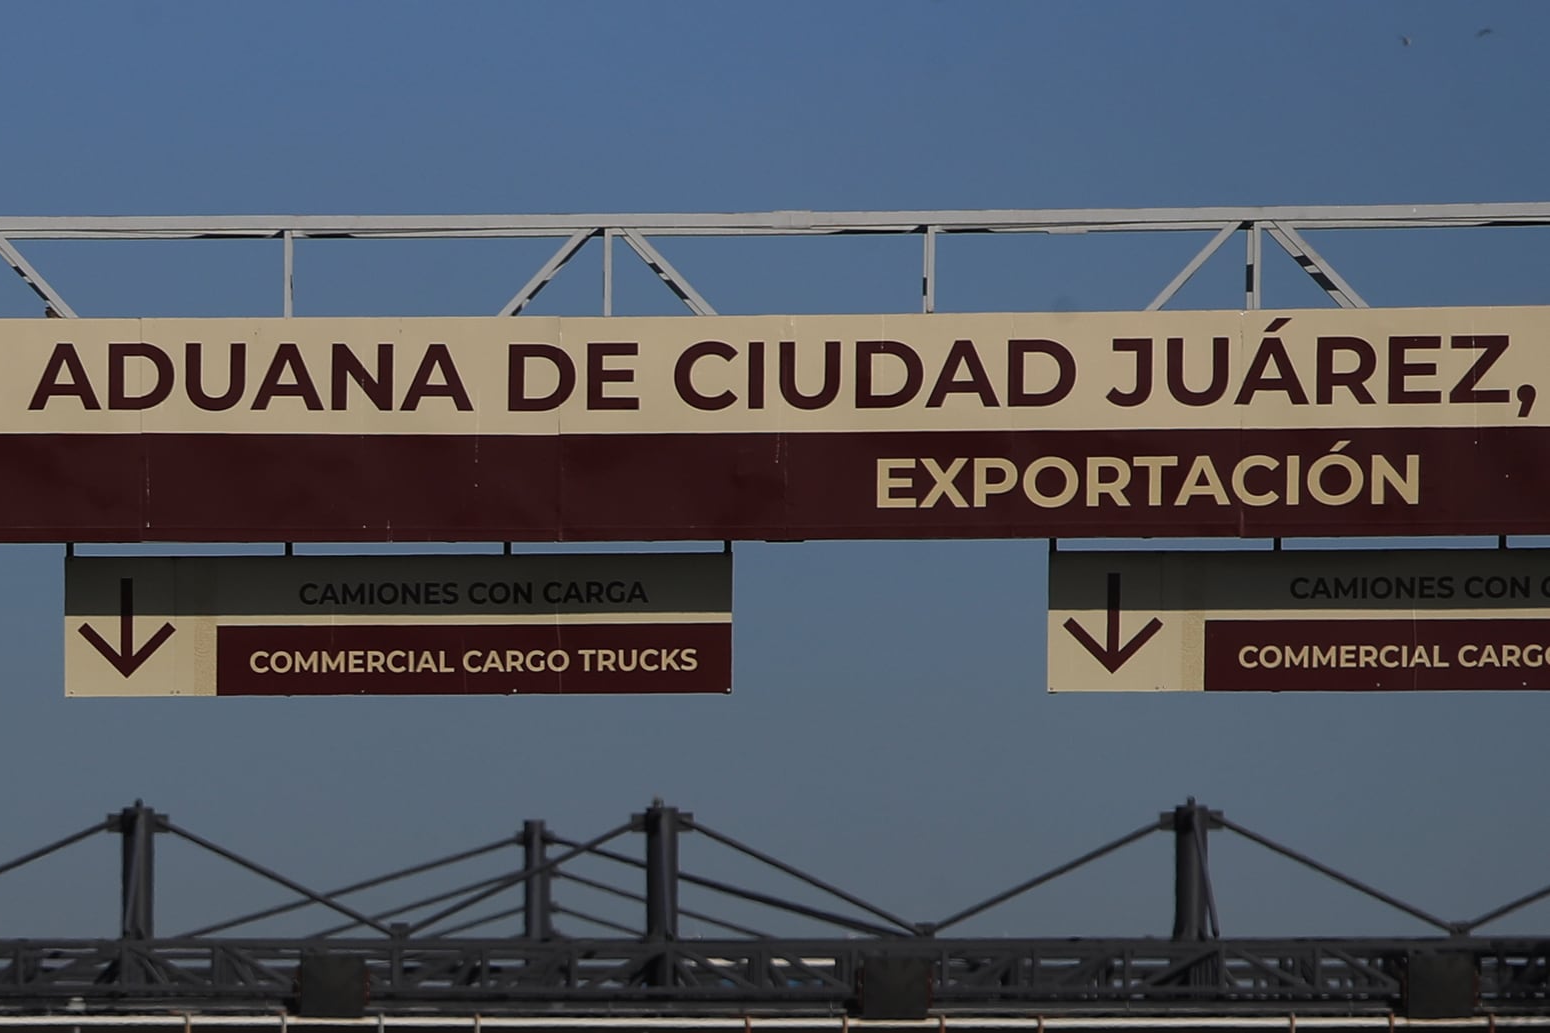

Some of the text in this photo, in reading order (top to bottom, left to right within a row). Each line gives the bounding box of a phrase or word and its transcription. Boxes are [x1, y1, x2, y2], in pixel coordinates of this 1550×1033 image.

[27, 317, 1537, 418] ADUANA DE CIUDAD JUÁREZ,
[876, 440, 1420, 509] EXPORTACIÓN
[298, 579, 649, 607] CAMIONES CON CARGA
[1289, 575, 1455, 600] CAMIONES
[1464, 575, 1531, 599] CON
[249, 647, 699, 675] COMMERCIAL CARGO TRUCKS
[1238, 644, 1550, 669] COMMERCIAL CARG
